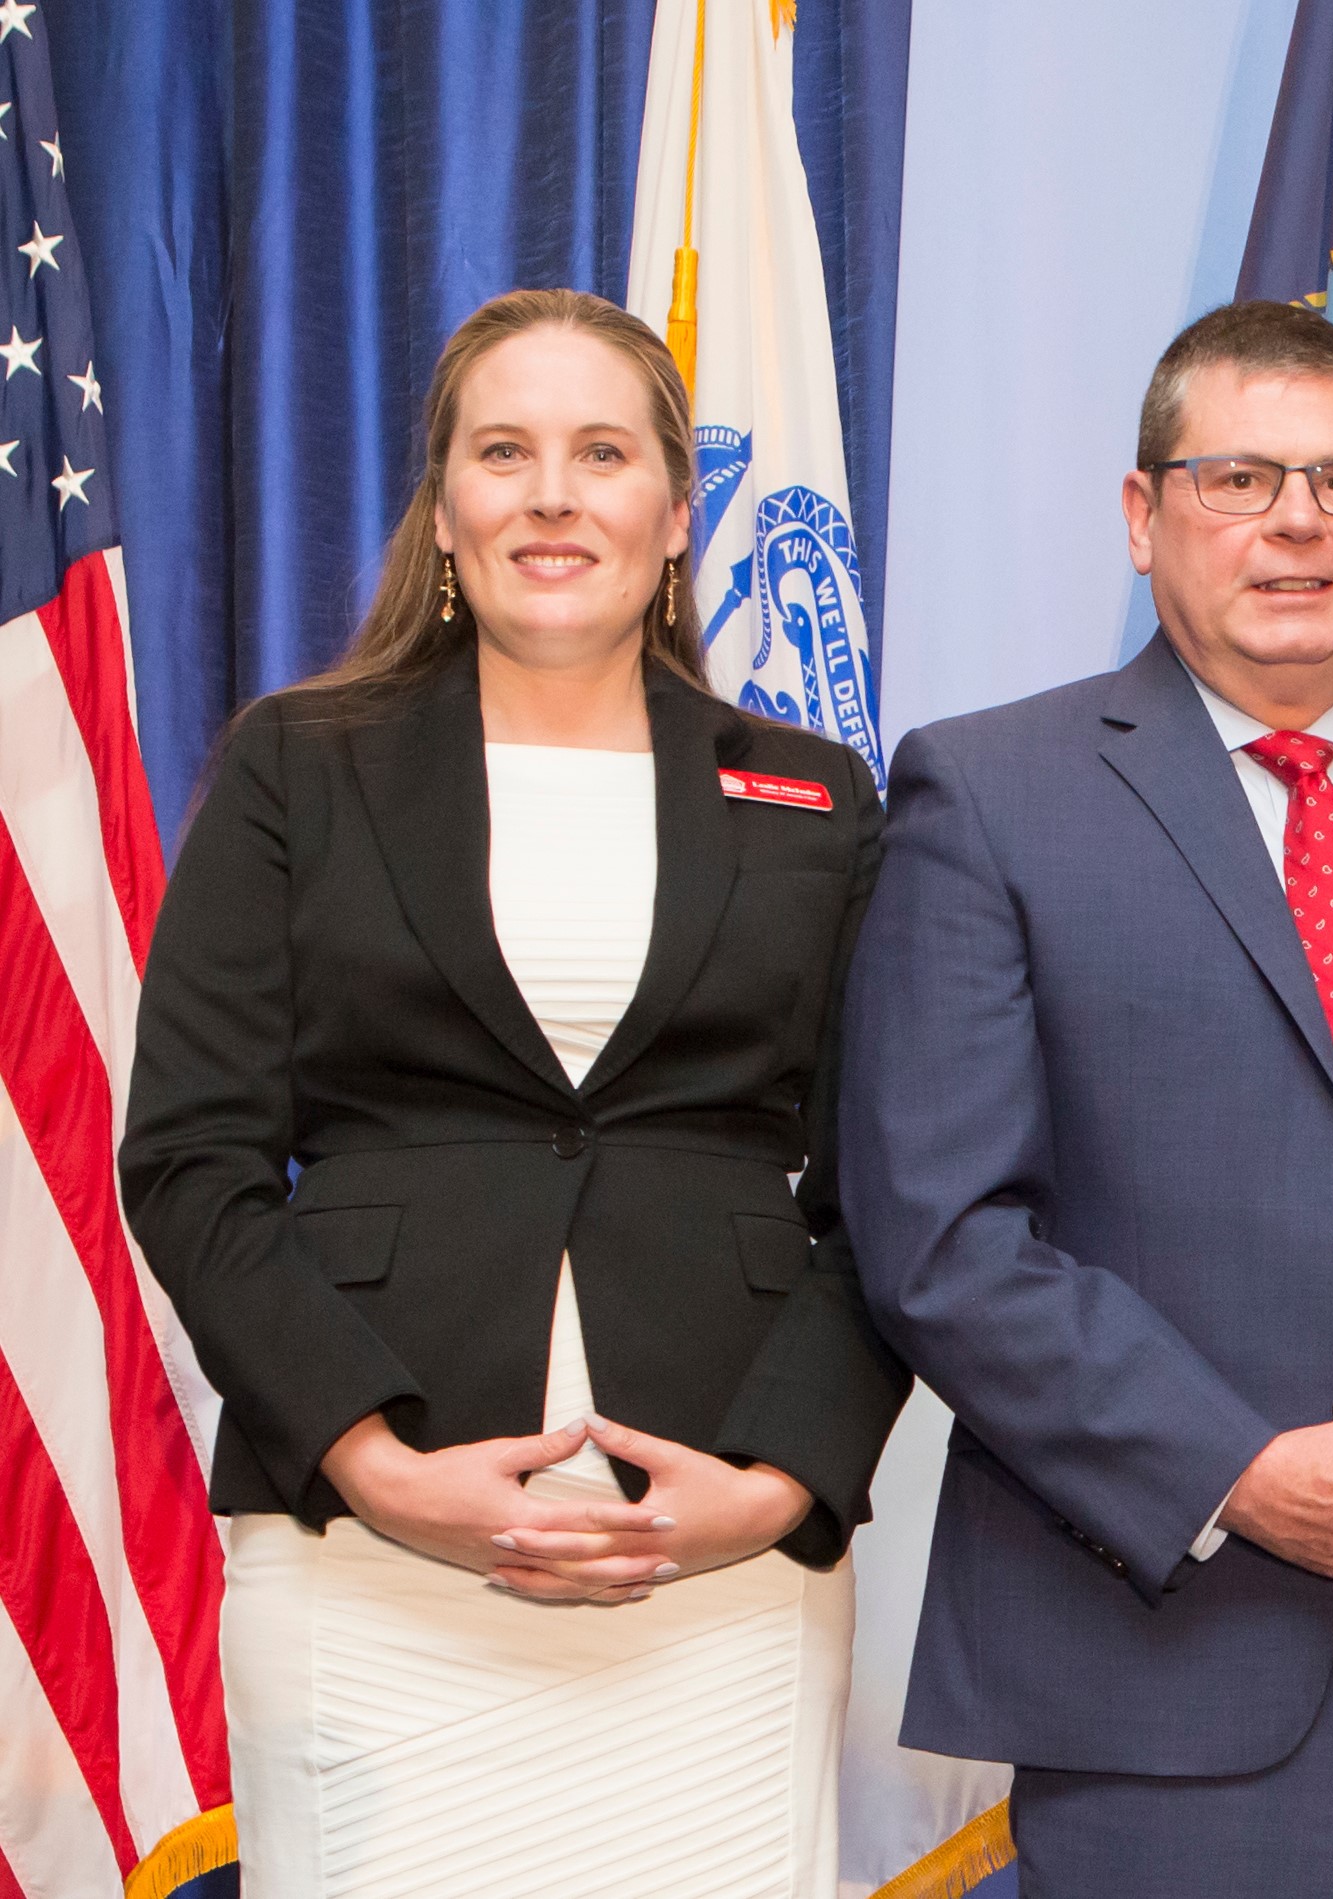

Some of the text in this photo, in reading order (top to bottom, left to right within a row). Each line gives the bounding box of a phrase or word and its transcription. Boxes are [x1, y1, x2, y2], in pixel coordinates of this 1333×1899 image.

[779, 540, 879, 787] THIS WE'LL DEFEN
